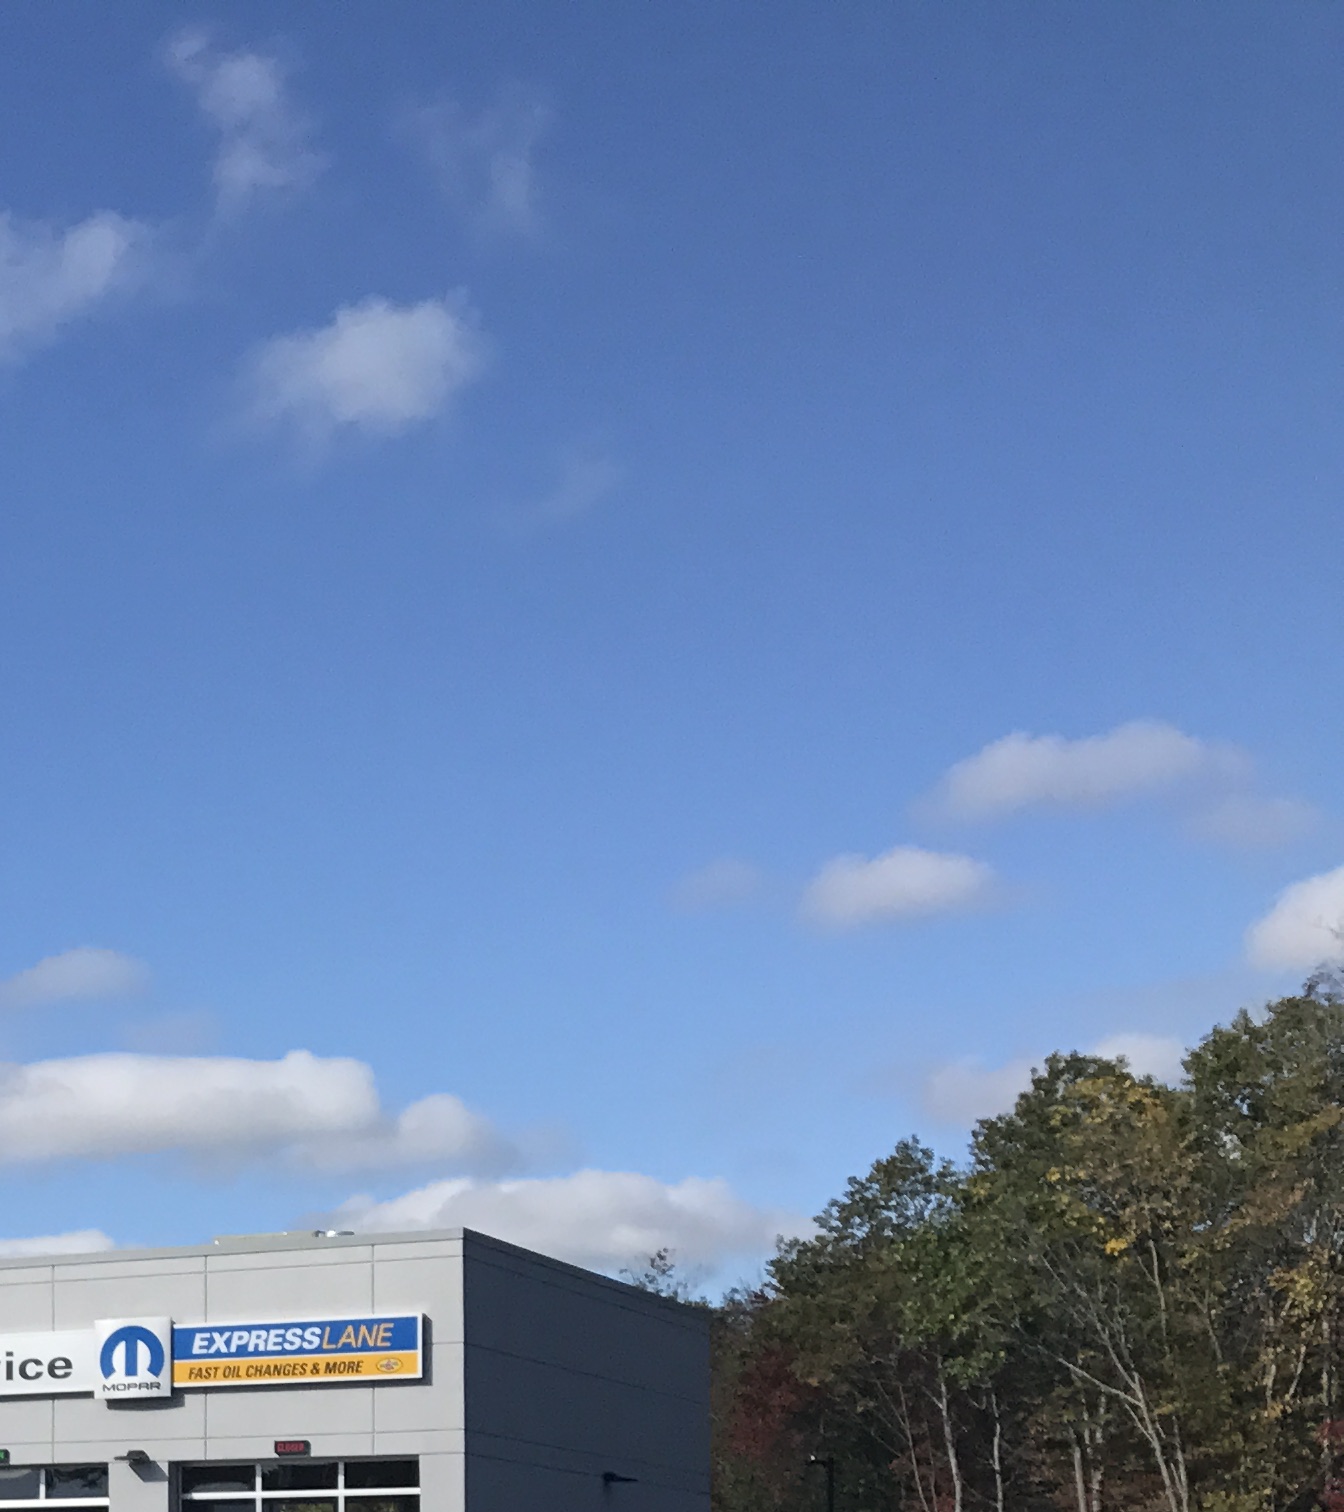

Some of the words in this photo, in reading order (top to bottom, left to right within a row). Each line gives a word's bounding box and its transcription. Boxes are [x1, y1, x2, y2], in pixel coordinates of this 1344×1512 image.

[188, 1366, 220, 1380] FAST
[222, 1365, 242, 1379] OIL
[245, 1362, 308, 1378] CHANGES
[310, 1361, 320, 1375] &
[324, 1359, 364, 1375] MORE
[102, 1381, 161, 1392] MOPAR
